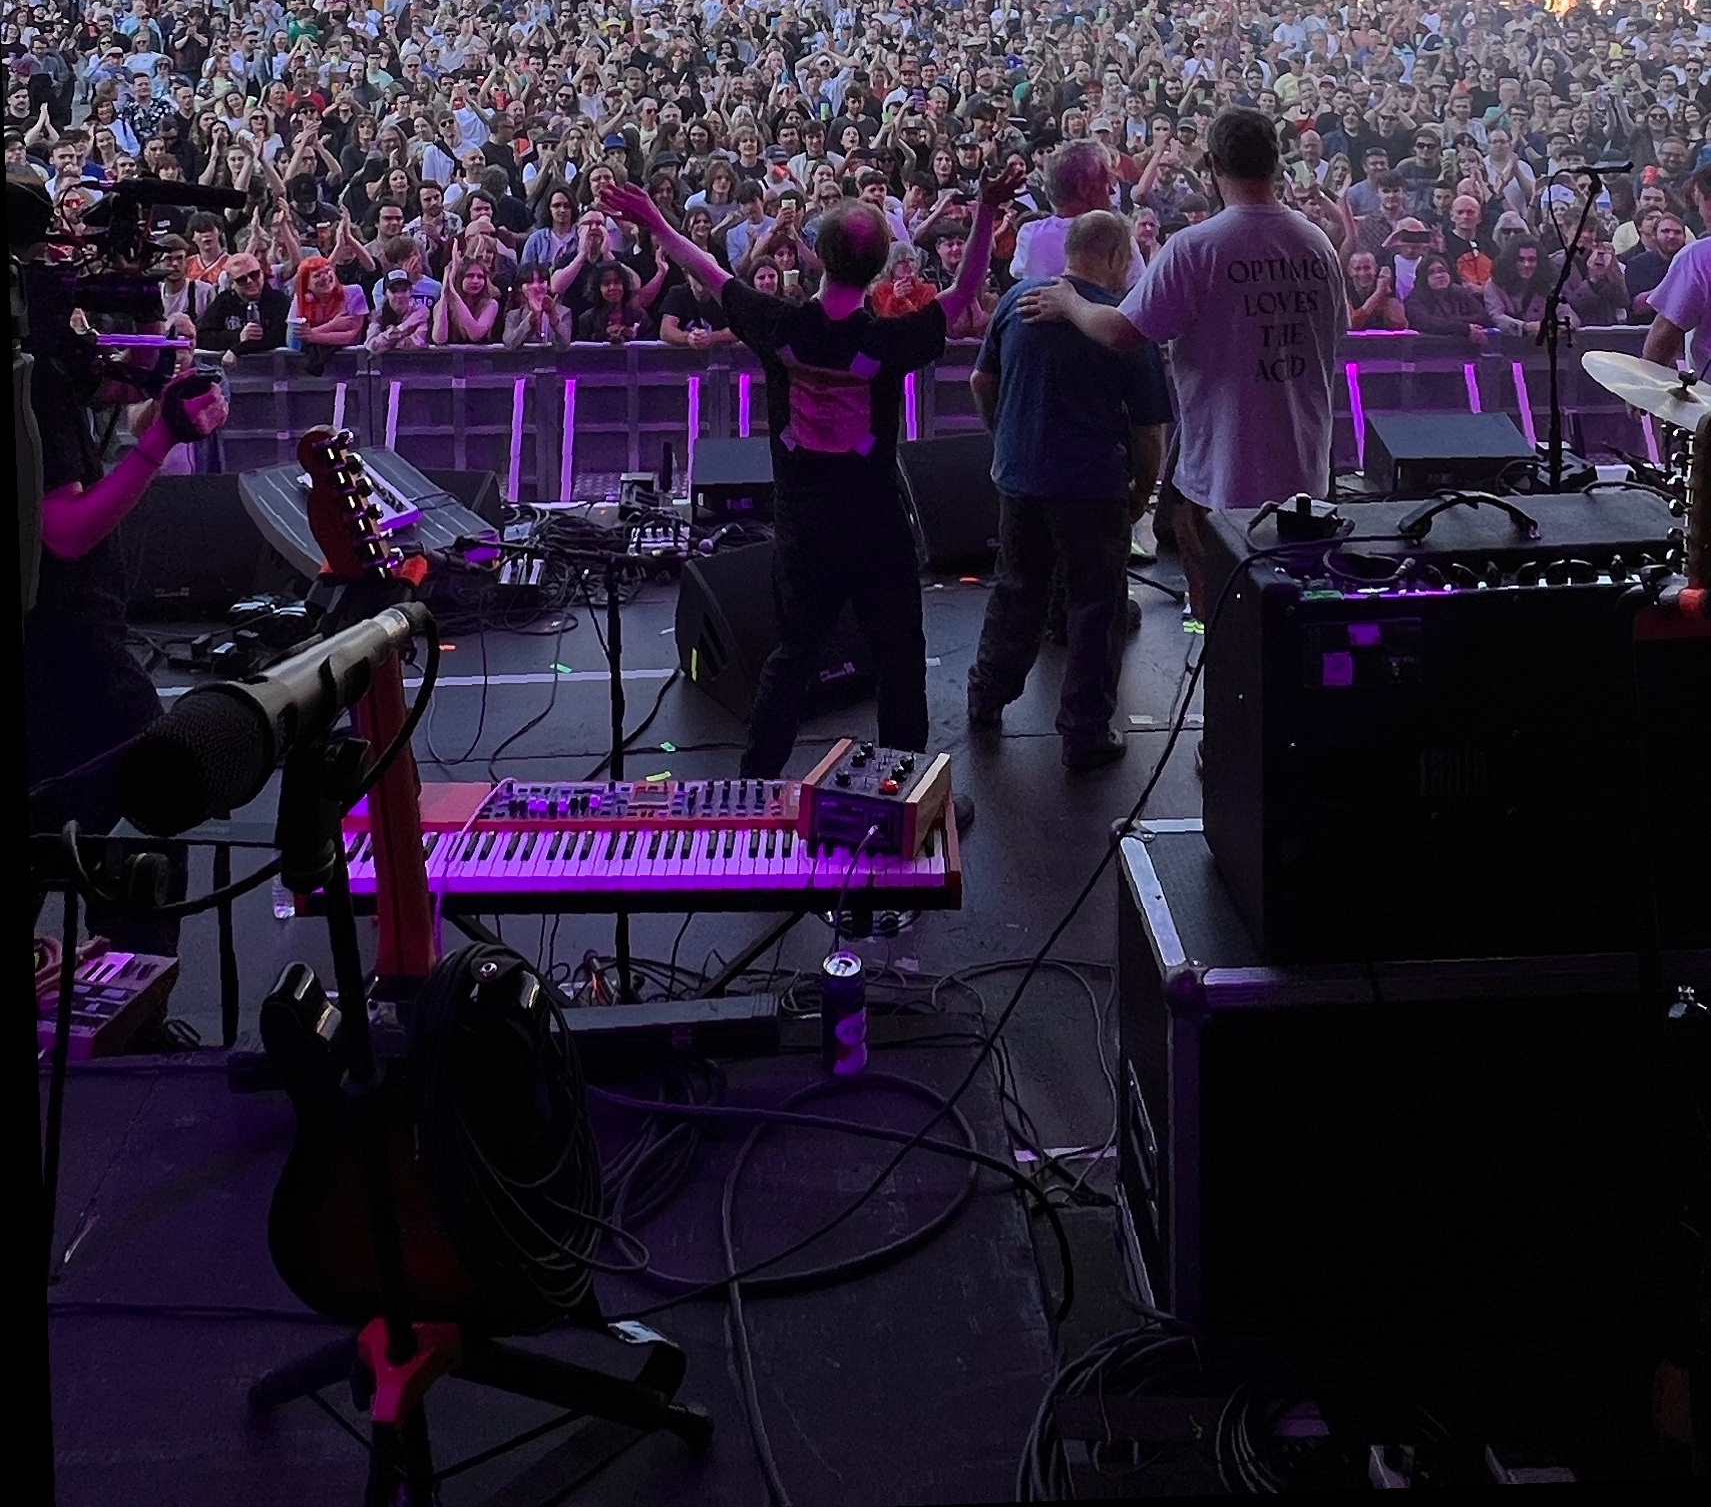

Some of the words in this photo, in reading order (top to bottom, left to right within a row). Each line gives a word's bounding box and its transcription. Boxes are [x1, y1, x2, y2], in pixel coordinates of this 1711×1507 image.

[1227, 257, 1328, 283] OPTIMO
[1244, 290, 1319, 317] LOVES
[1256, 354, 1306, 383] ACD
